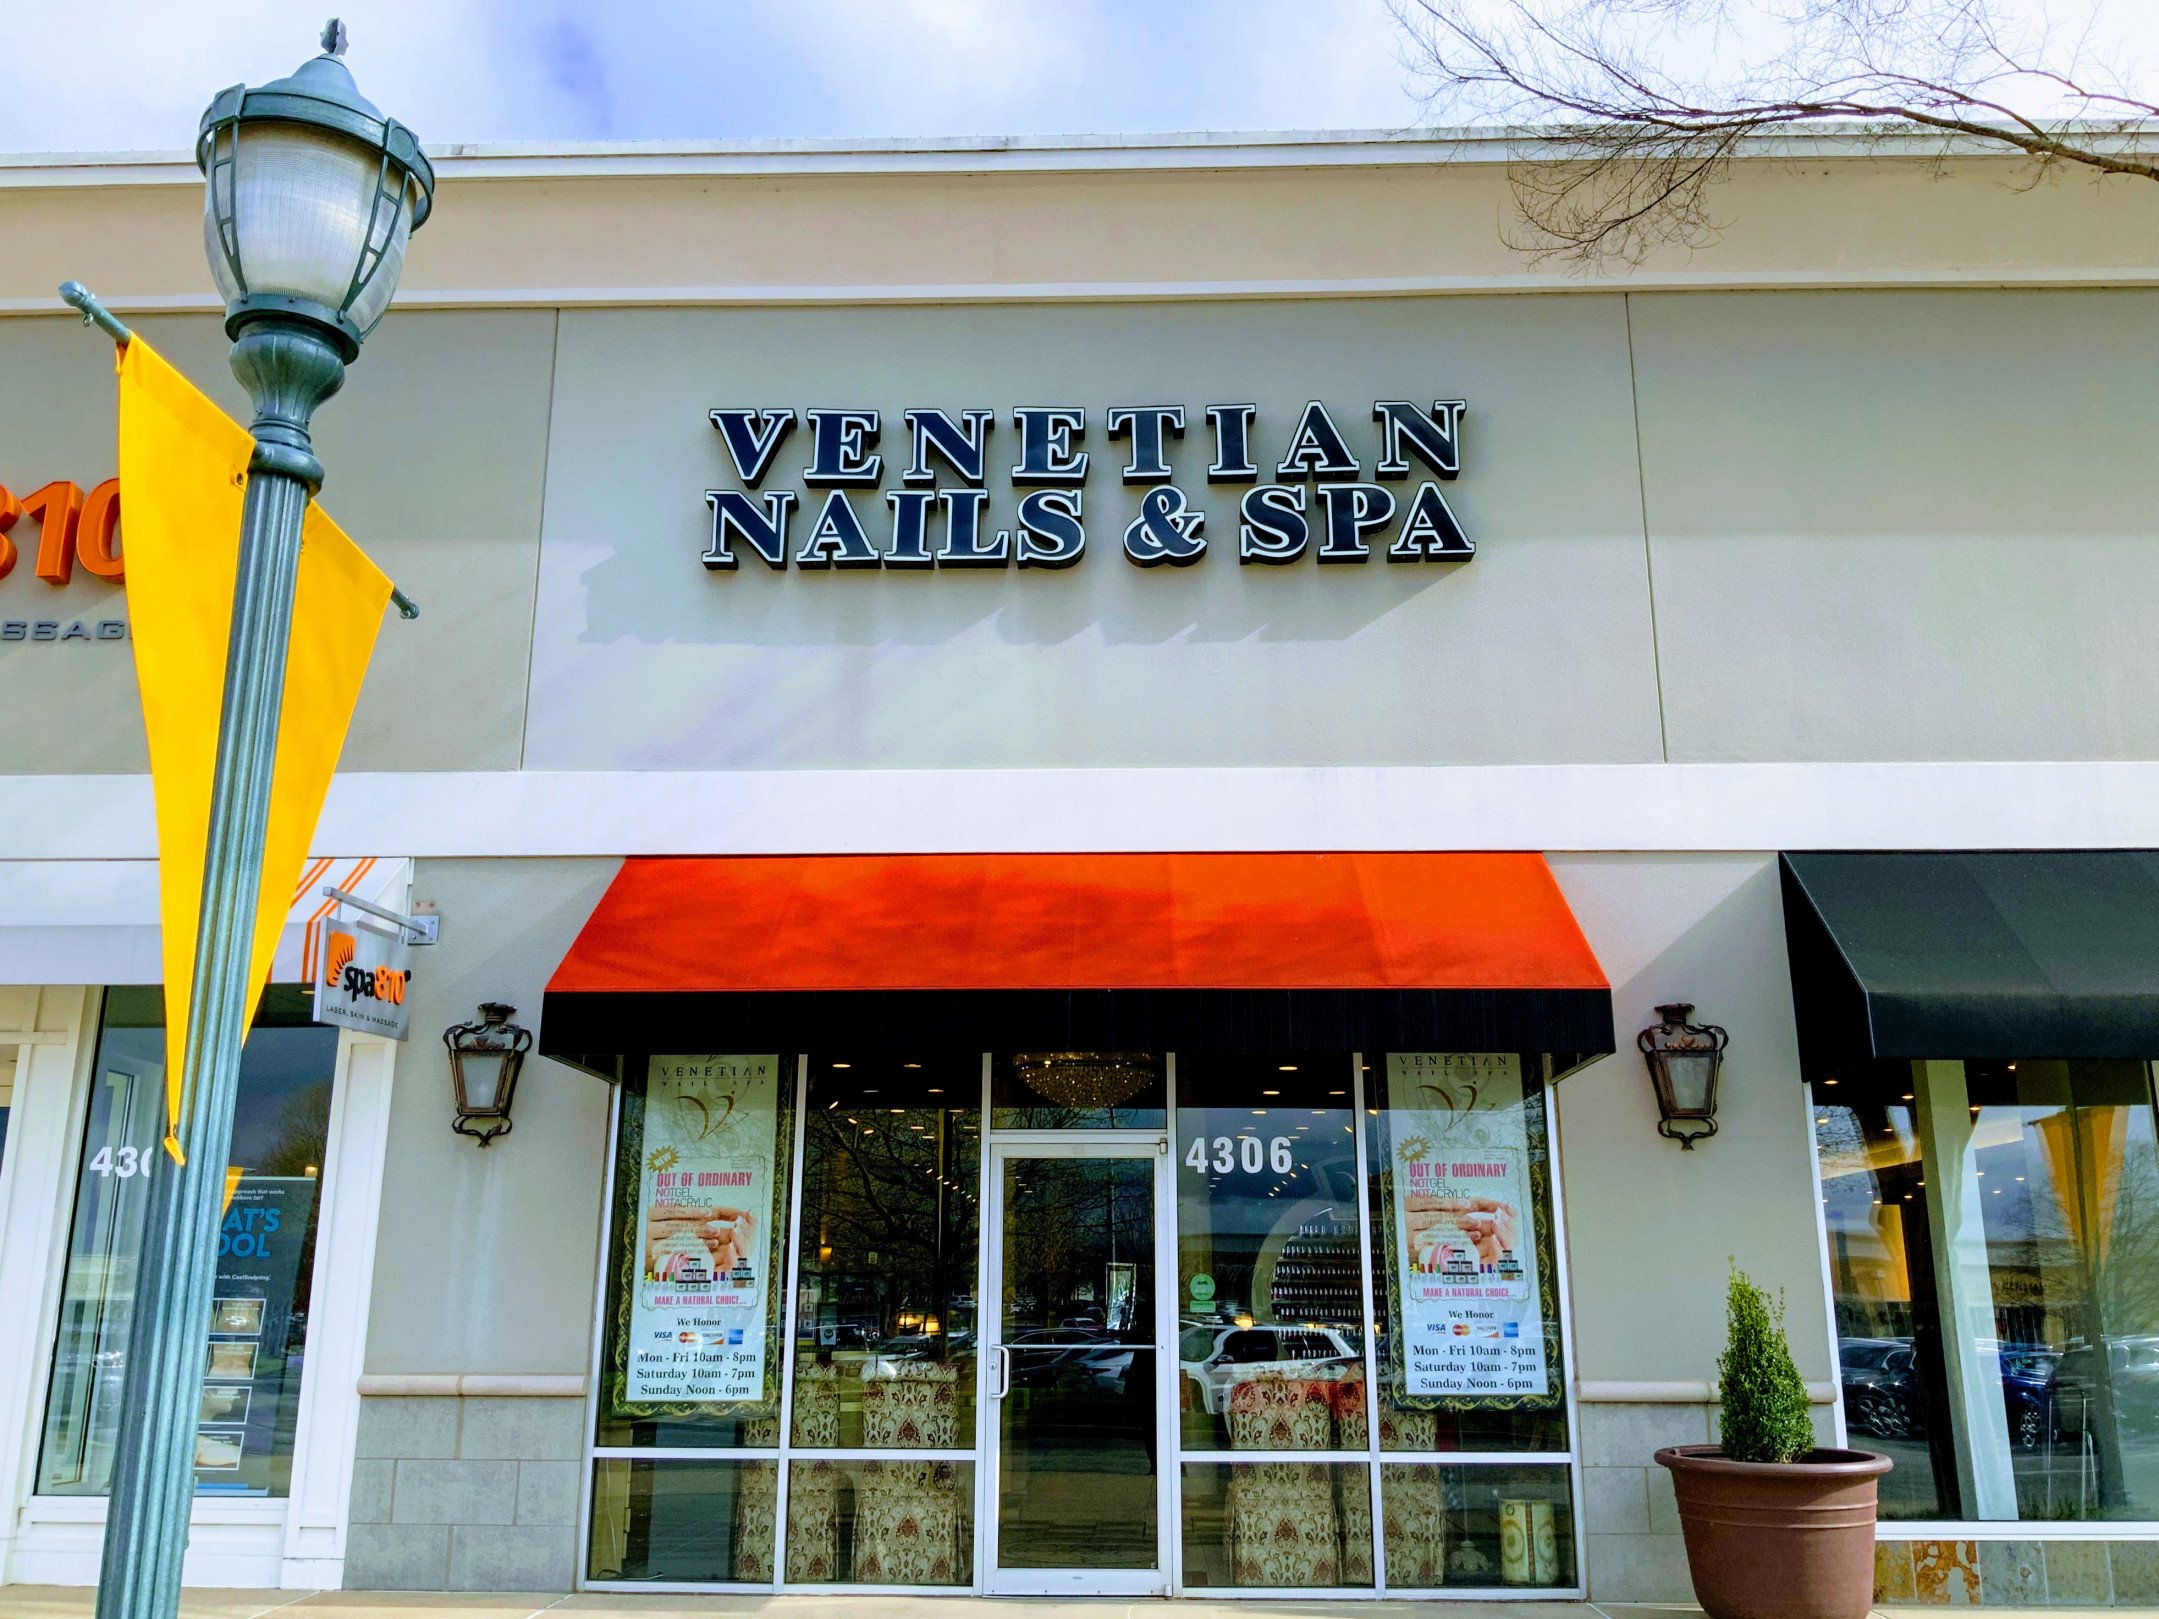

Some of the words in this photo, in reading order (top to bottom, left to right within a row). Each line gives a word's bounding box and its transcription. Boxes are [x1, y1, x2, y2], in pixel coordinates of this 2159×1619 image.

[709, 399, 1467, 486] VENETIAN
[702, 488, 1086, 569] NAILS
[1122, 484, 1208, 568] &
[1239, 481, 1477, 566] SPA
[0, 620, 132, 641] SSAG
[350, 1010, 365, 1020] SKIN
[371, 1015, 399, 1029] MASSAGE
[1399, 1055, 1508, 1067] VENETIAN
[661, 1064, 767, 1078] VENETIAN
[1184, 1135, 1294, 1175] 4306
[1409, 1162, 1430, 1178] OUT
[1434, 1162, 1448, 1178] OF
[1451, 1162, 1507, 1178] ORDINARY
[656, 1172, 677, 1188] OUT
[681, 1172, 694, 1187] OF
[698, 1171, 752, 1187] ORDINARY
[222, 1207, 281, 1233] AT'S
[217, 1232, 271, 1258] OOL
[1423, 1287, 1443, 1297] MAKE
[1445, 1287, 1450, 1297] A
[1451, 1287, 1483, 1297] NATURAL
[654, 1295, 674, 1305] MAKE
[675, 1295, 681, 1305] A
[682, 1295, 714, 1305] NATURAL
[677, 1317, 691, 1326] We
[693, 1317, 722, 1326] Honor
[1448, 1310, 1463, 1319] We
[1465, 1310, 1494, 1319] Honor
[1426, 1323, 1447, 1331] VISA
[654, 1331, 673, 1339] VISA
[637, 1351, 663, 1363] Mon
[672, 1351, 690, 1363] Fri
[694, 1351, 723, 1362] 10am
[732, 1351, 757, 1365] 8pm
[1413, 1345, 1439, 1356] Mon
[1449, 1345, 1466, 1356] Fri
[1470, 1345, 1501, 1356] 10am
[1510, 1345, 1536, 1358] 8pm
[636, 1368, 688, 1380] Saturday
[691, 1368, 721, 1379] 10am
[731, 1368, 755, 1381] 7pm
[1414, 1361, 1466, 1374] Saturday
[1470, 1361, 1501, 1372] 10am
[1511, 1361, 1537, 1374] 7pm
[640, 1384, 683, 1397] Sunday
[686, 1384, 715, 1395] Noon
[725, 1384, 749, 1397] 6pm
[1420, 1377, 1463, 1391] Sunday
[1466, 1377, 1498, 1389] Noon
[1507, 1377, 1533, 1391] 6pm
